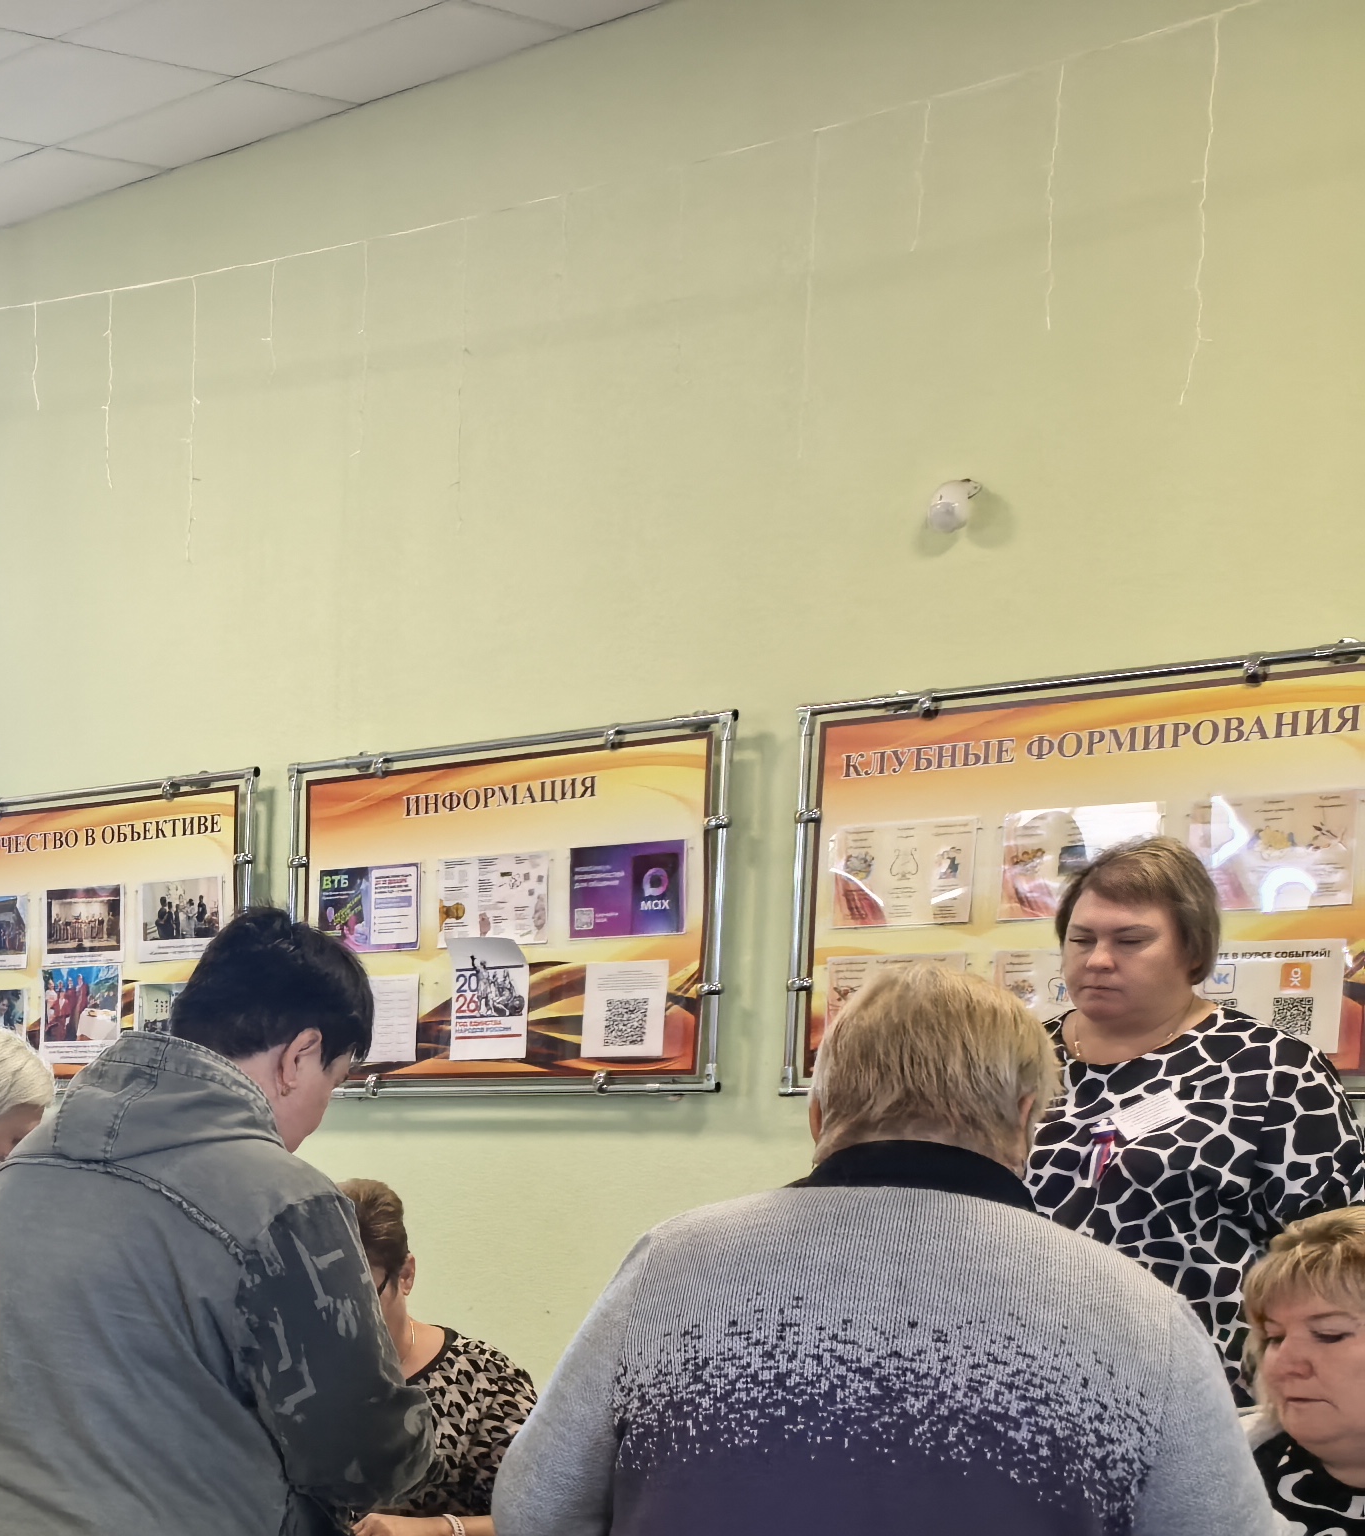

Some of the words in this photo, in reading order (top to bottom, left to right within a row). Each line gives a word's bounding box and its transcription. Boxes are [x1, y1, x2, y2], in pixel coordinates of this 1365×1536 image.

[842, 738, 1015, 780] КЛУБНЫЕ
[1026, 703, 1362, 761] ФОРМИРОВАНИЯ
[404, 775, 598, 817] ИНФОРМАЦИЯ
[84, 827, 97, 848] В
[101, 813, 223, 845] ОБЪЕКТИВЕ
[322, 874, 349, 890] ВТБ
[1241, 951, 1272, 960] КУРСЕ
[1274, 948, 1331, 959] СОБЫТИЙ!
[455, 972, 479, 994] 20
[455, 993, 479, 1014] 26
